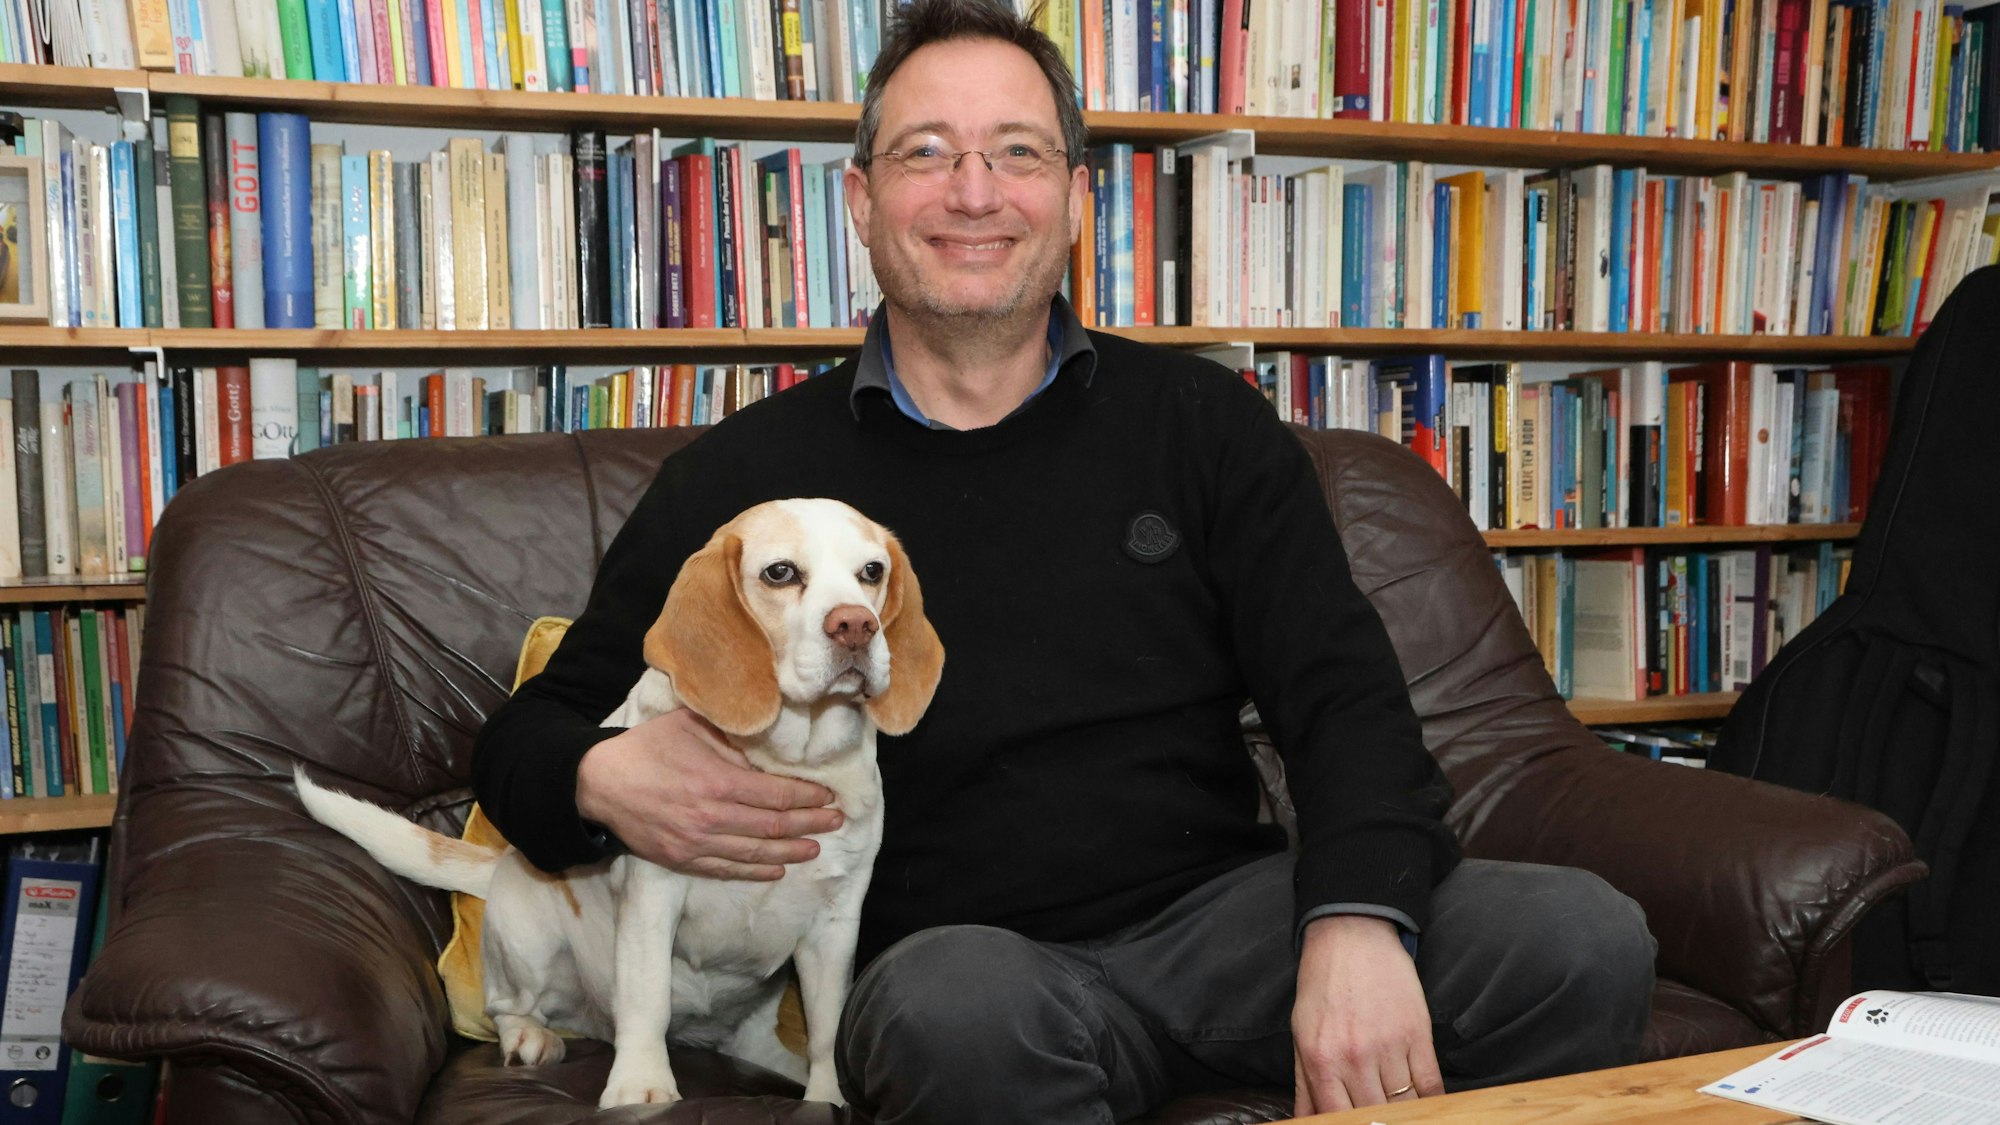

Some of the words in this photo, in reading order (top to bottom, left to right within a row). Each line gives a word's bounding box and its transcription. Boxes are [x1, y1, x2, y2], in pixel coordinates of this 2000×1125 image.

[231, 139, 259, 214] GOTT
[722, 203, 730, 216] der
[722, 216, 731, 239] Praxis
[670, 272, 679, 290] BETZ
[671, 290, 679, 318] ROBERT
[727, 294, 736, 320] Fischer
[226, 382, 241, 422] Gott?
[230, 423, 240, 458] Warum
[1521, 419, 1534, 445] BOOM
[1521, 469, 1534, 502] CORRIE
